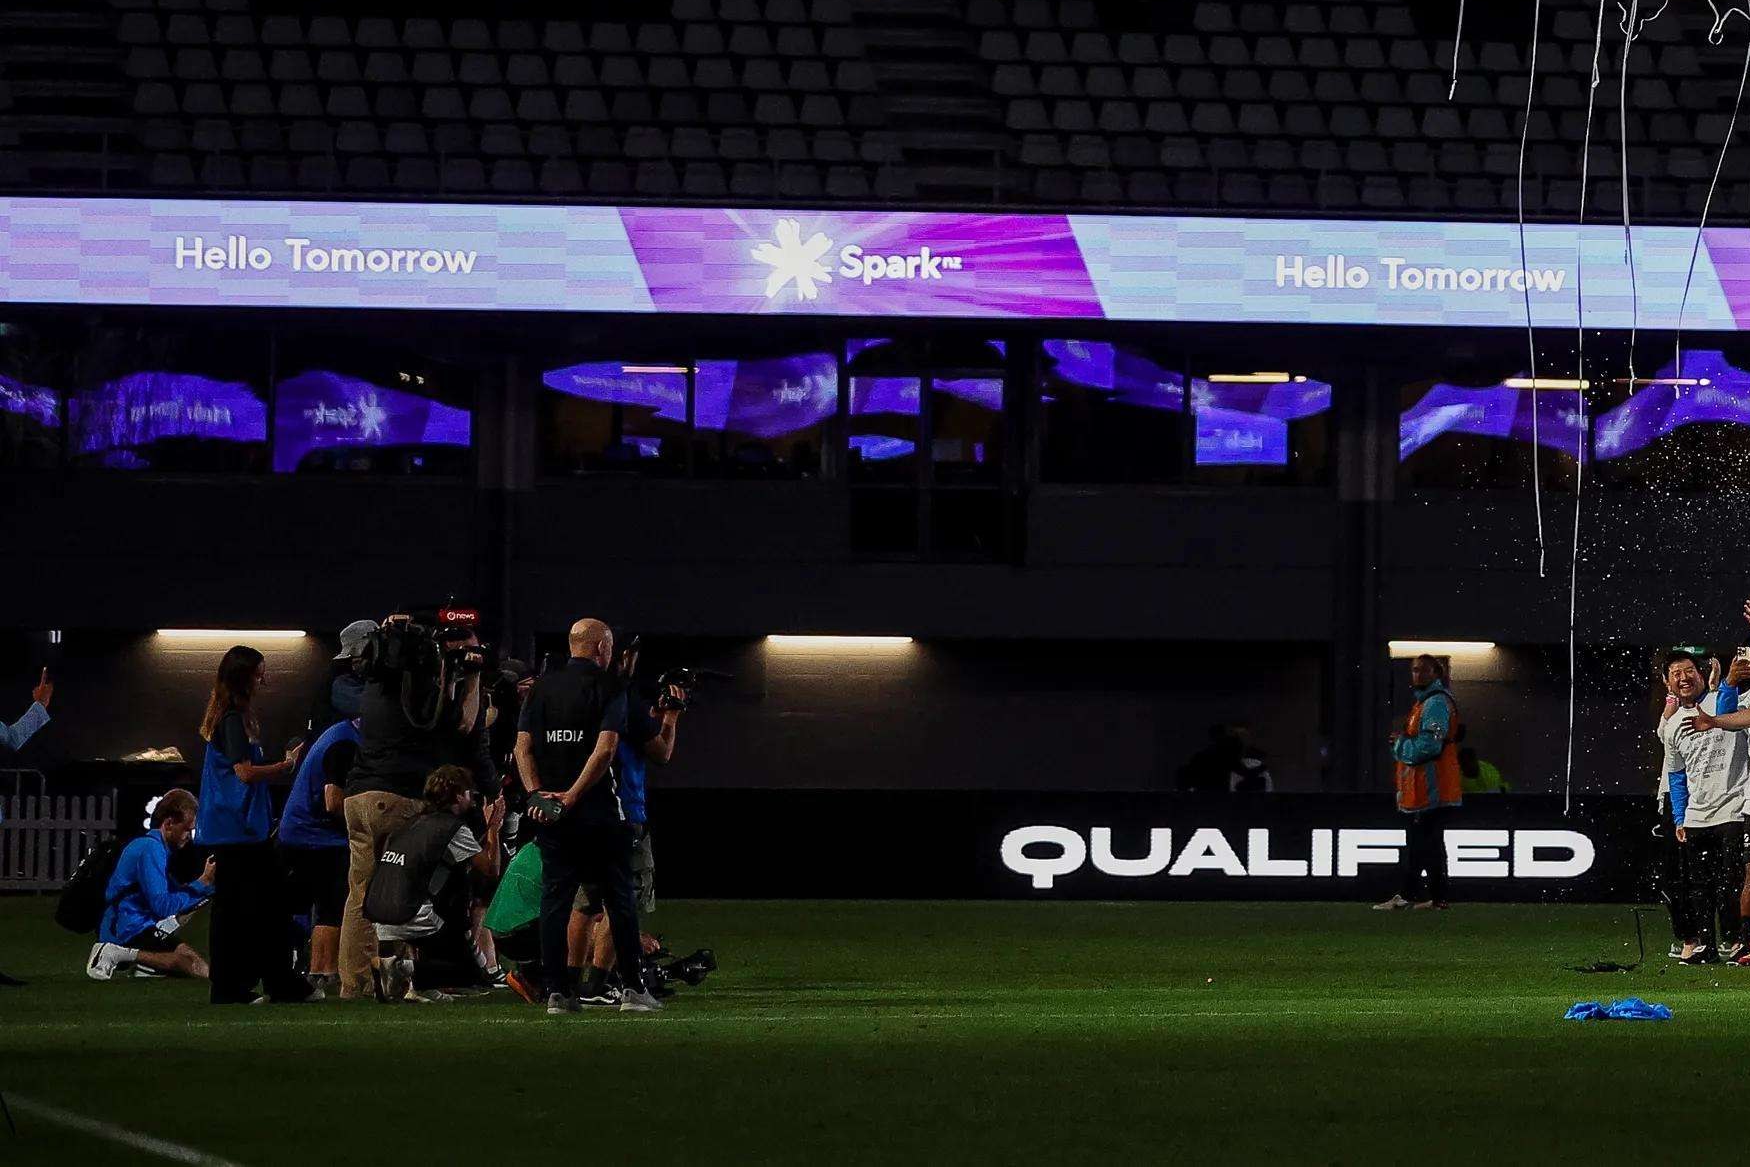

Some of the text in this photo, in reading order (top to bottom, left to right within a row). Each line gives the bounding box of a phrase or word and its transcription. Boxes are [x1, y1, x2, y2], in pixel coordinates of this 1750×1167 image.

[175, 235, 477, 274] Hello Tomorrow
[839, 244, 942, 285] Spark
[1276, 254, 1566, 292] Hello Tomorrow
[546, 729, 584, 743] MEDIA
[380, 850, 406, 866] EDIA
[1001, 825, 1596, 889] QUALIFED
